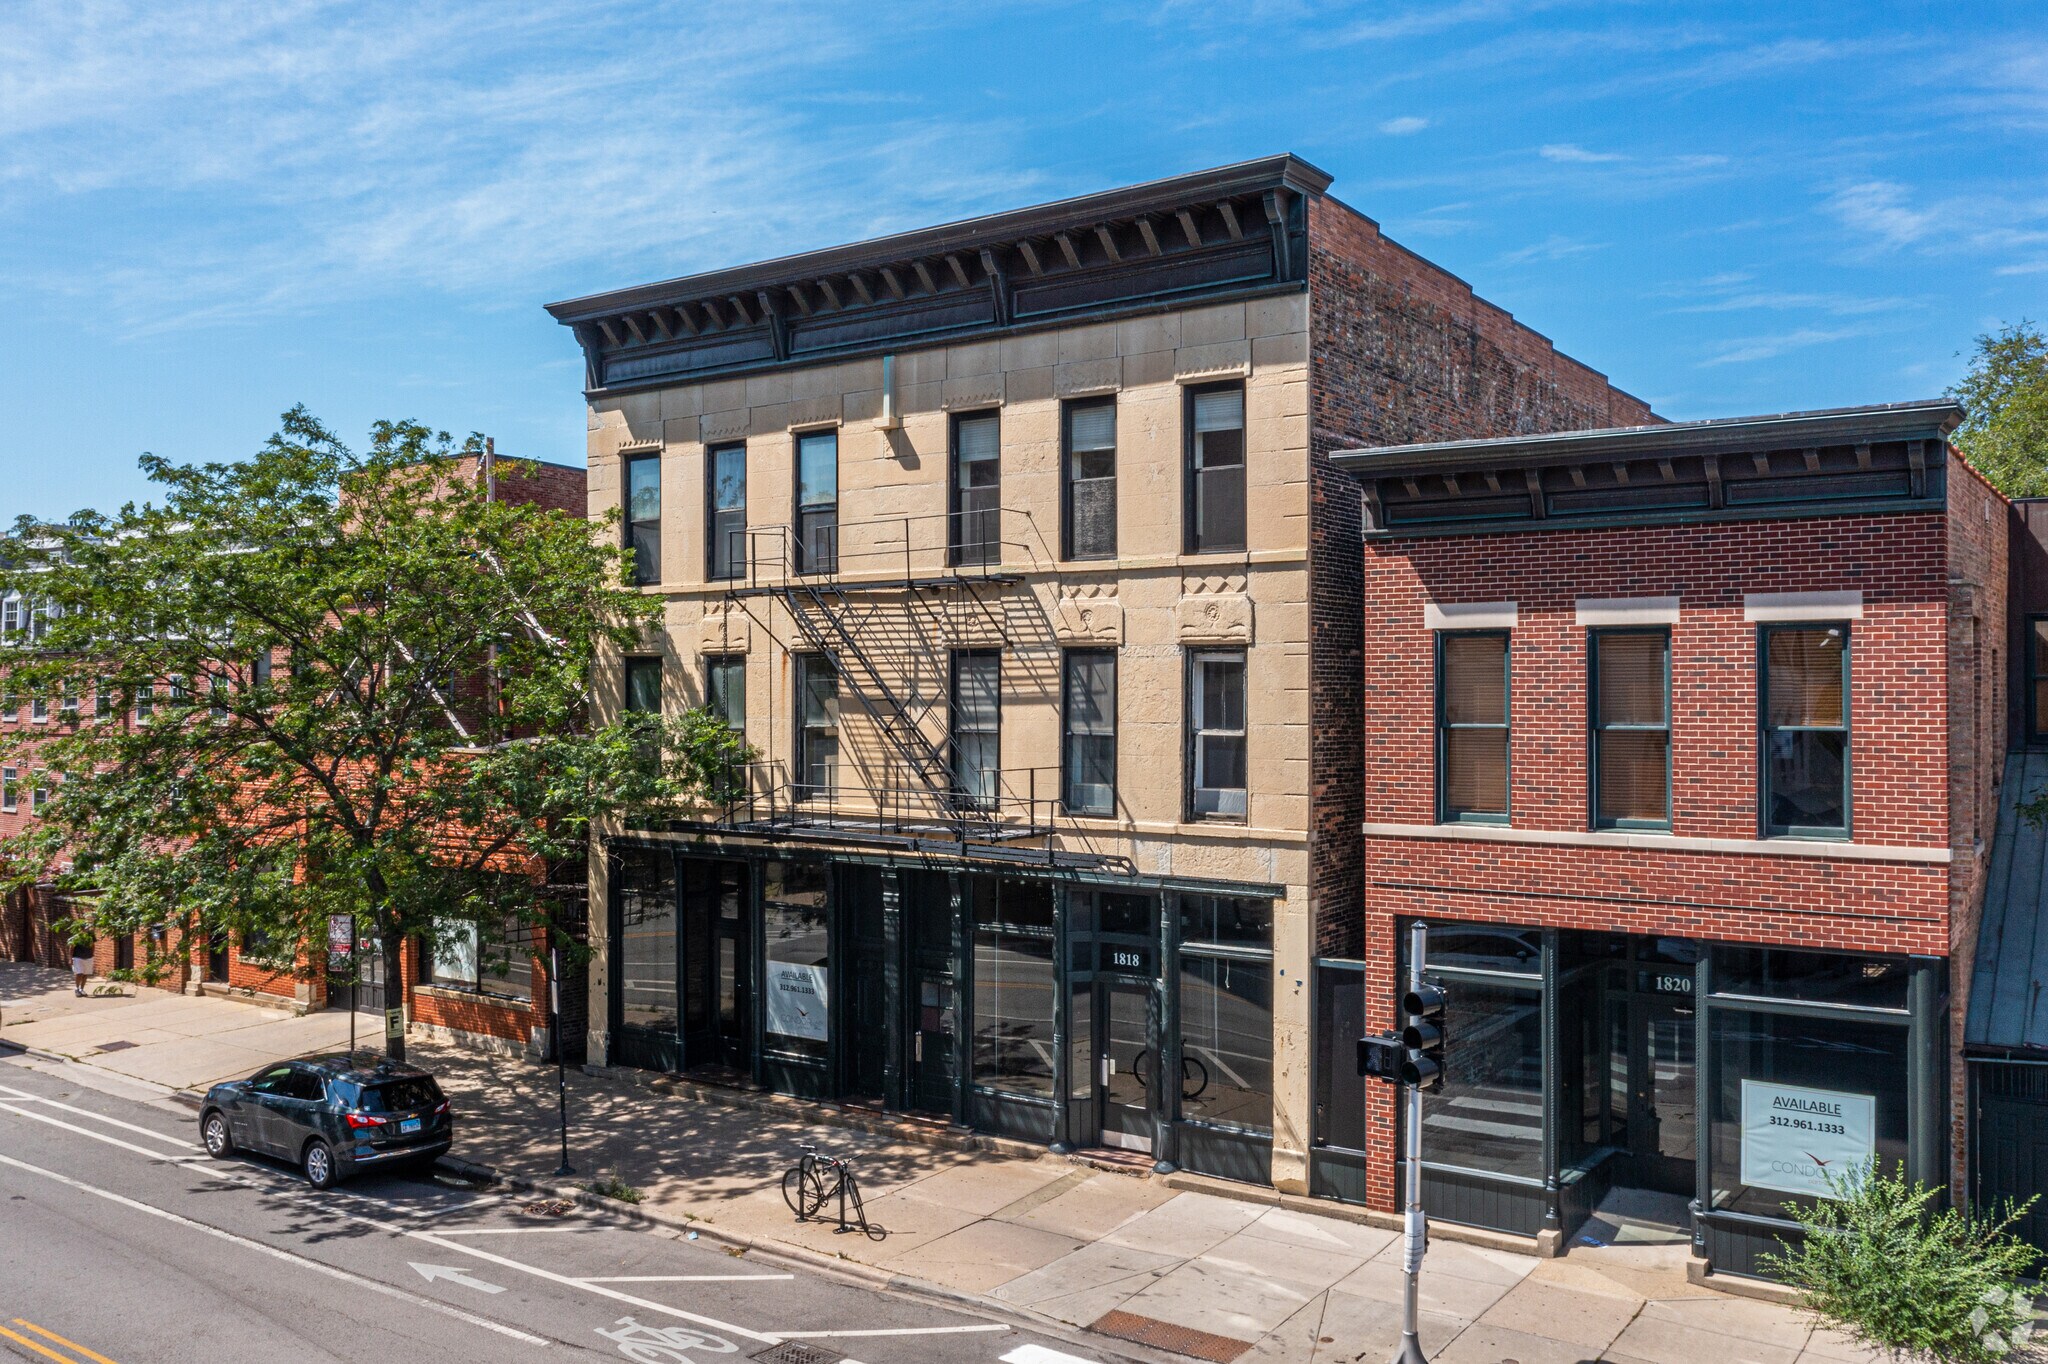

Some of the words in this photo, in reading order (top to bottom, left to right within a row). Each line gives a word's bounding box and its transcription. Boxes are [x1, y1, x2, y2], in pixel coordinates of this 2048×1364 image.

[1113, 952, 1140, 967] 1818
[781, 970, 813, 981] AVAILABLE
[780, 983, 815, 995] 312.961.1333
[1655, 976, 1691, 992] 1820
[390, 1015, 399, 1029] F
[1773, 1095, 1842, 1115] AVAILABLE
[1769, 1115, 1845, 1135] 312.961.1333
